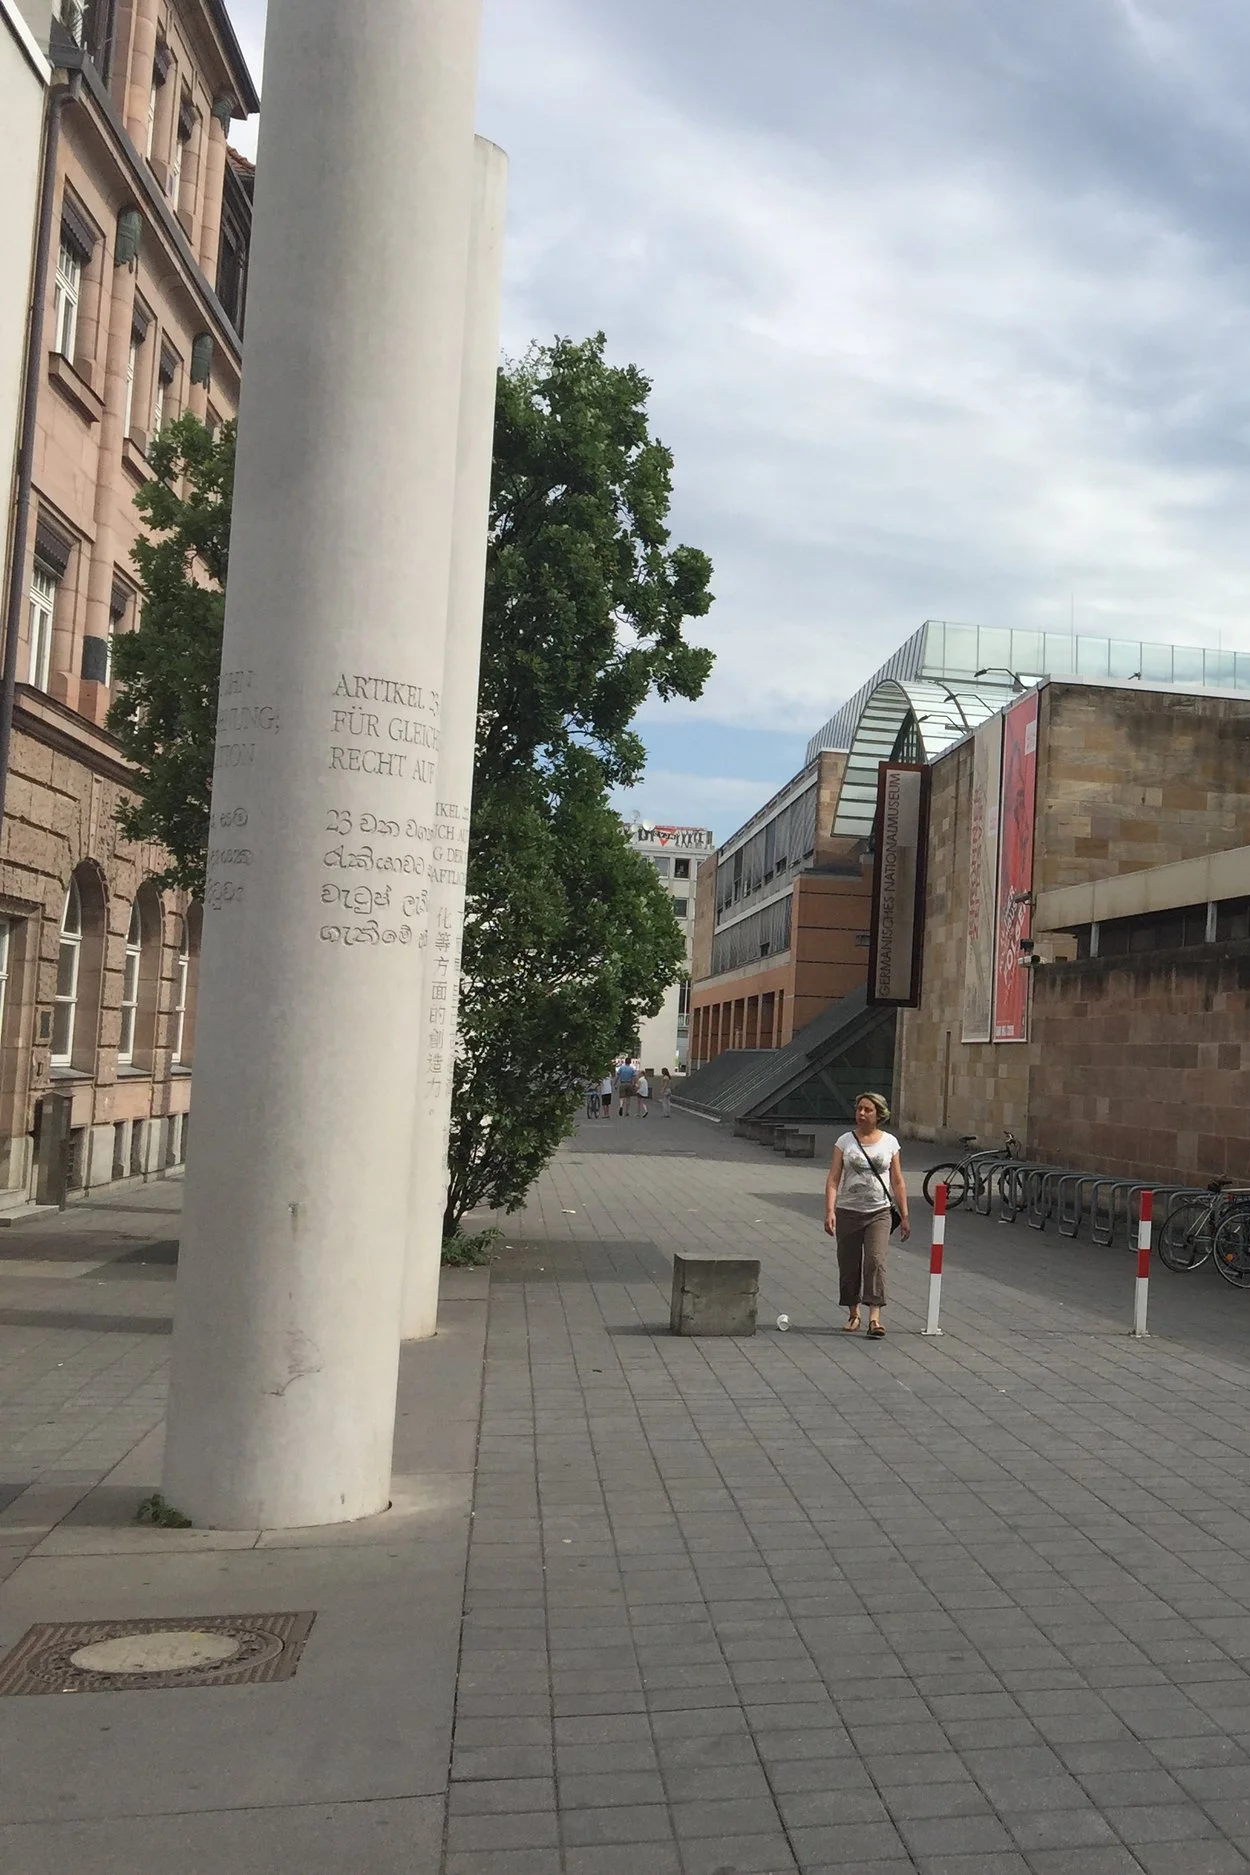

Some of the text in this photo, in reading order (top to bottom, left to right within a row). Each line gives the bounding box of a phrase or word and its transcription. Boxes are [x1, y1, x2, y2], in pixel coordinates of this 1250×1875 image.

[332, 674, 425, 709] ARTIKEL
[331, 706, 380, 737] FÜR
[328, 746, 435, 784] RECHT AUF
[878, 772, 901, 998] GERMANISCHES NATIONALMUSEUM
